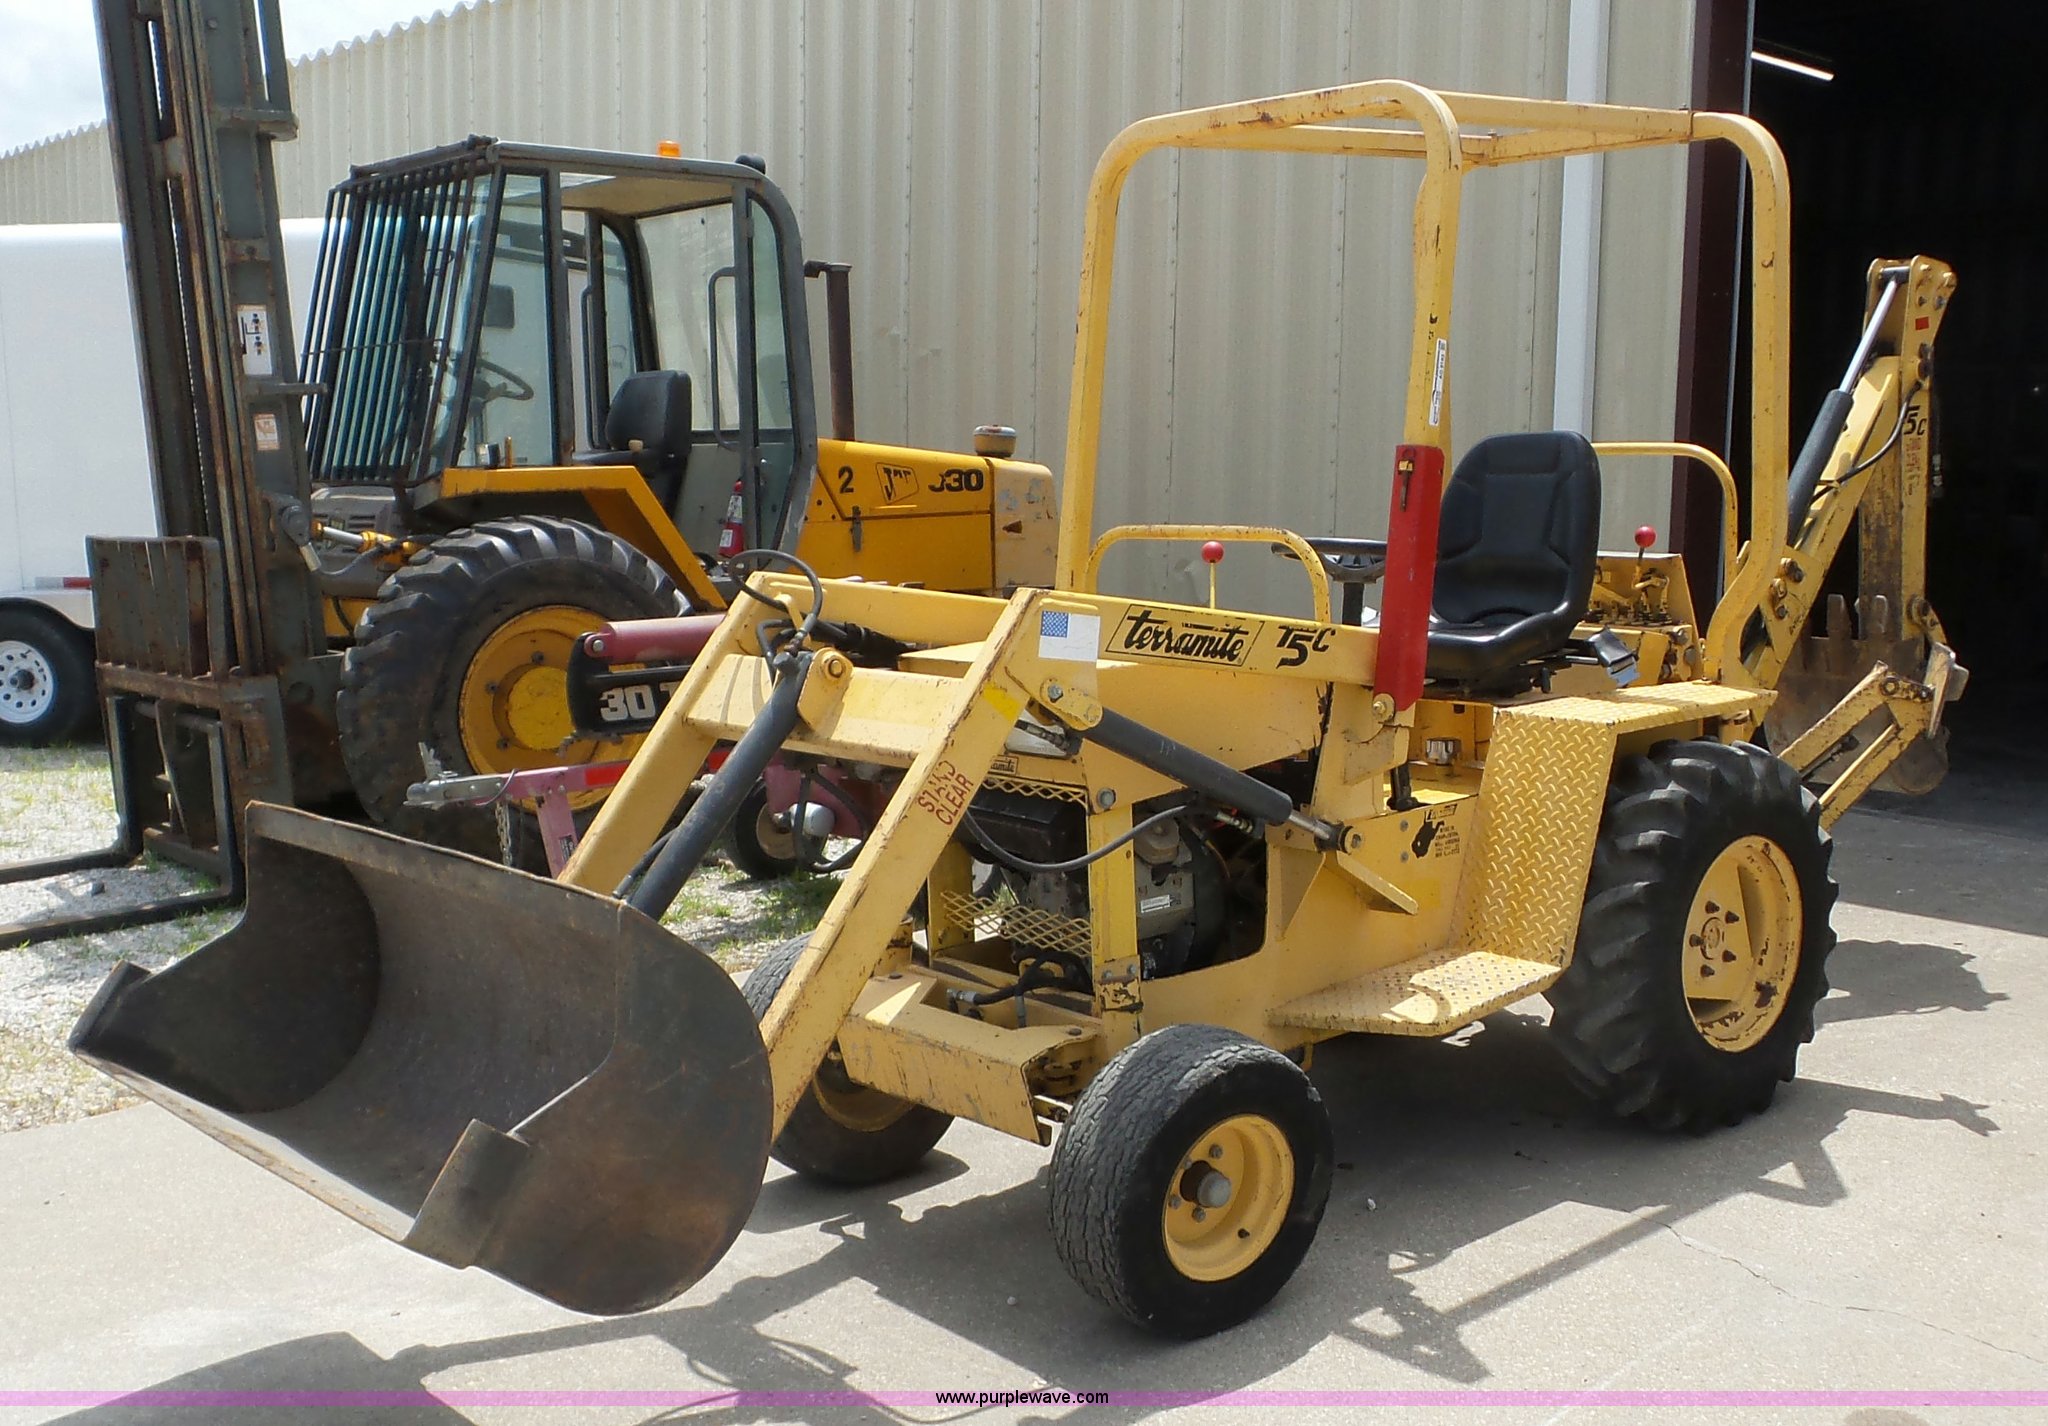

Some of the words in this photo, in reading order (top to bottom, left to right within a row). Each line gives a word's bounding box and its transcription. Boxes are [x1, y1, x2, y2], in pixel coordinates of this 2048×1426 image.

[838, 466, 855, 494] 2
[1126, 609, 1249, 662] terramite
[600, 684, 656, 721] 30
[935, 774, 974, 826] CLEAR
